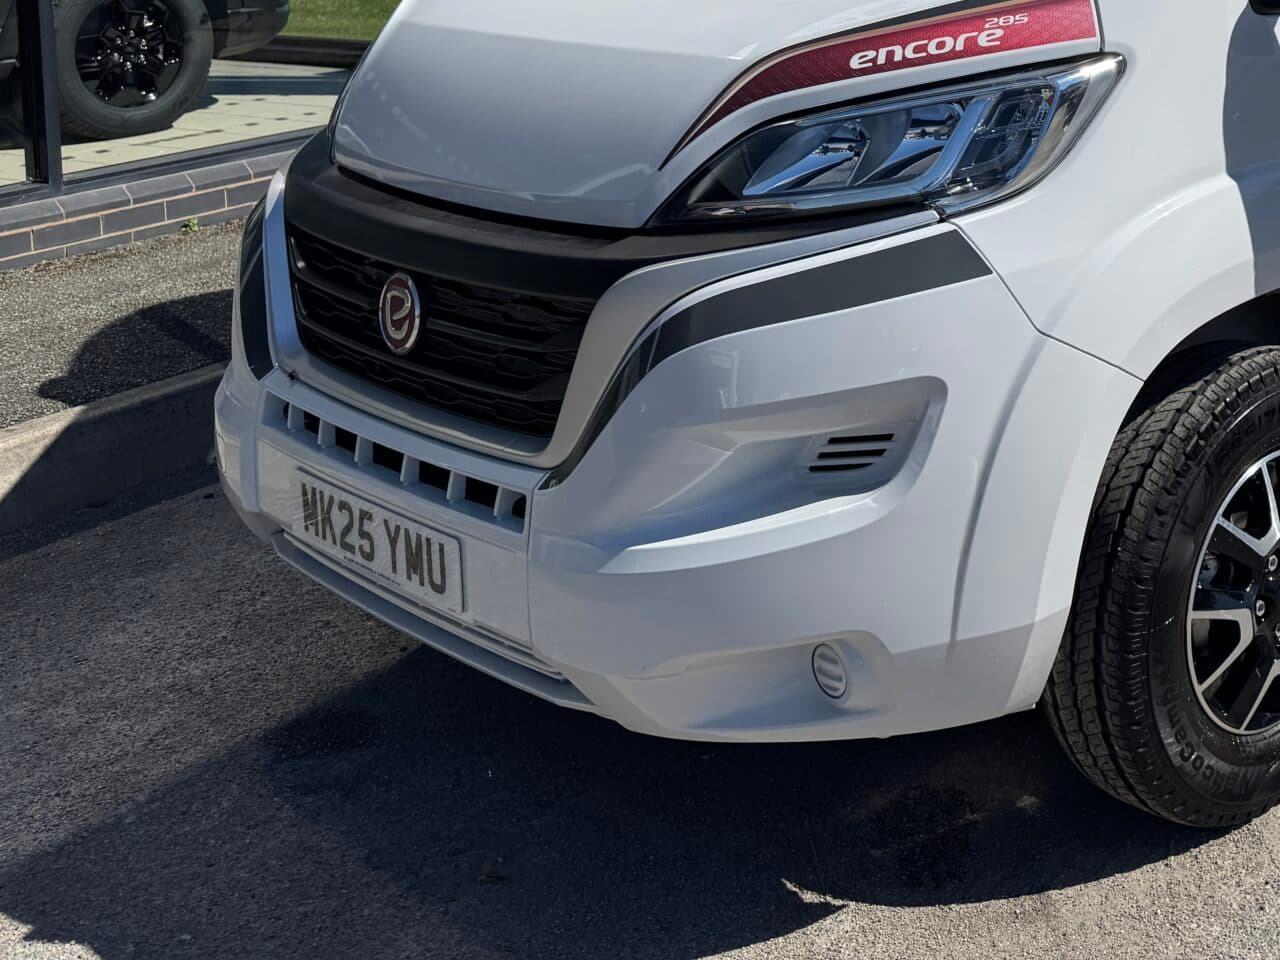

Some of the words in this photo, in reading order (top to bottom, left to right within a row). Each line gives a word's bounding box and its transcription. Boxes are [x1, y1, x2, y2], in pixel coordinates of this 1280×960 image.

[849, 28, 1005, 70] encore
[984, 12, 1029, 29] 285
[383, 518, 447, 596] YMU
